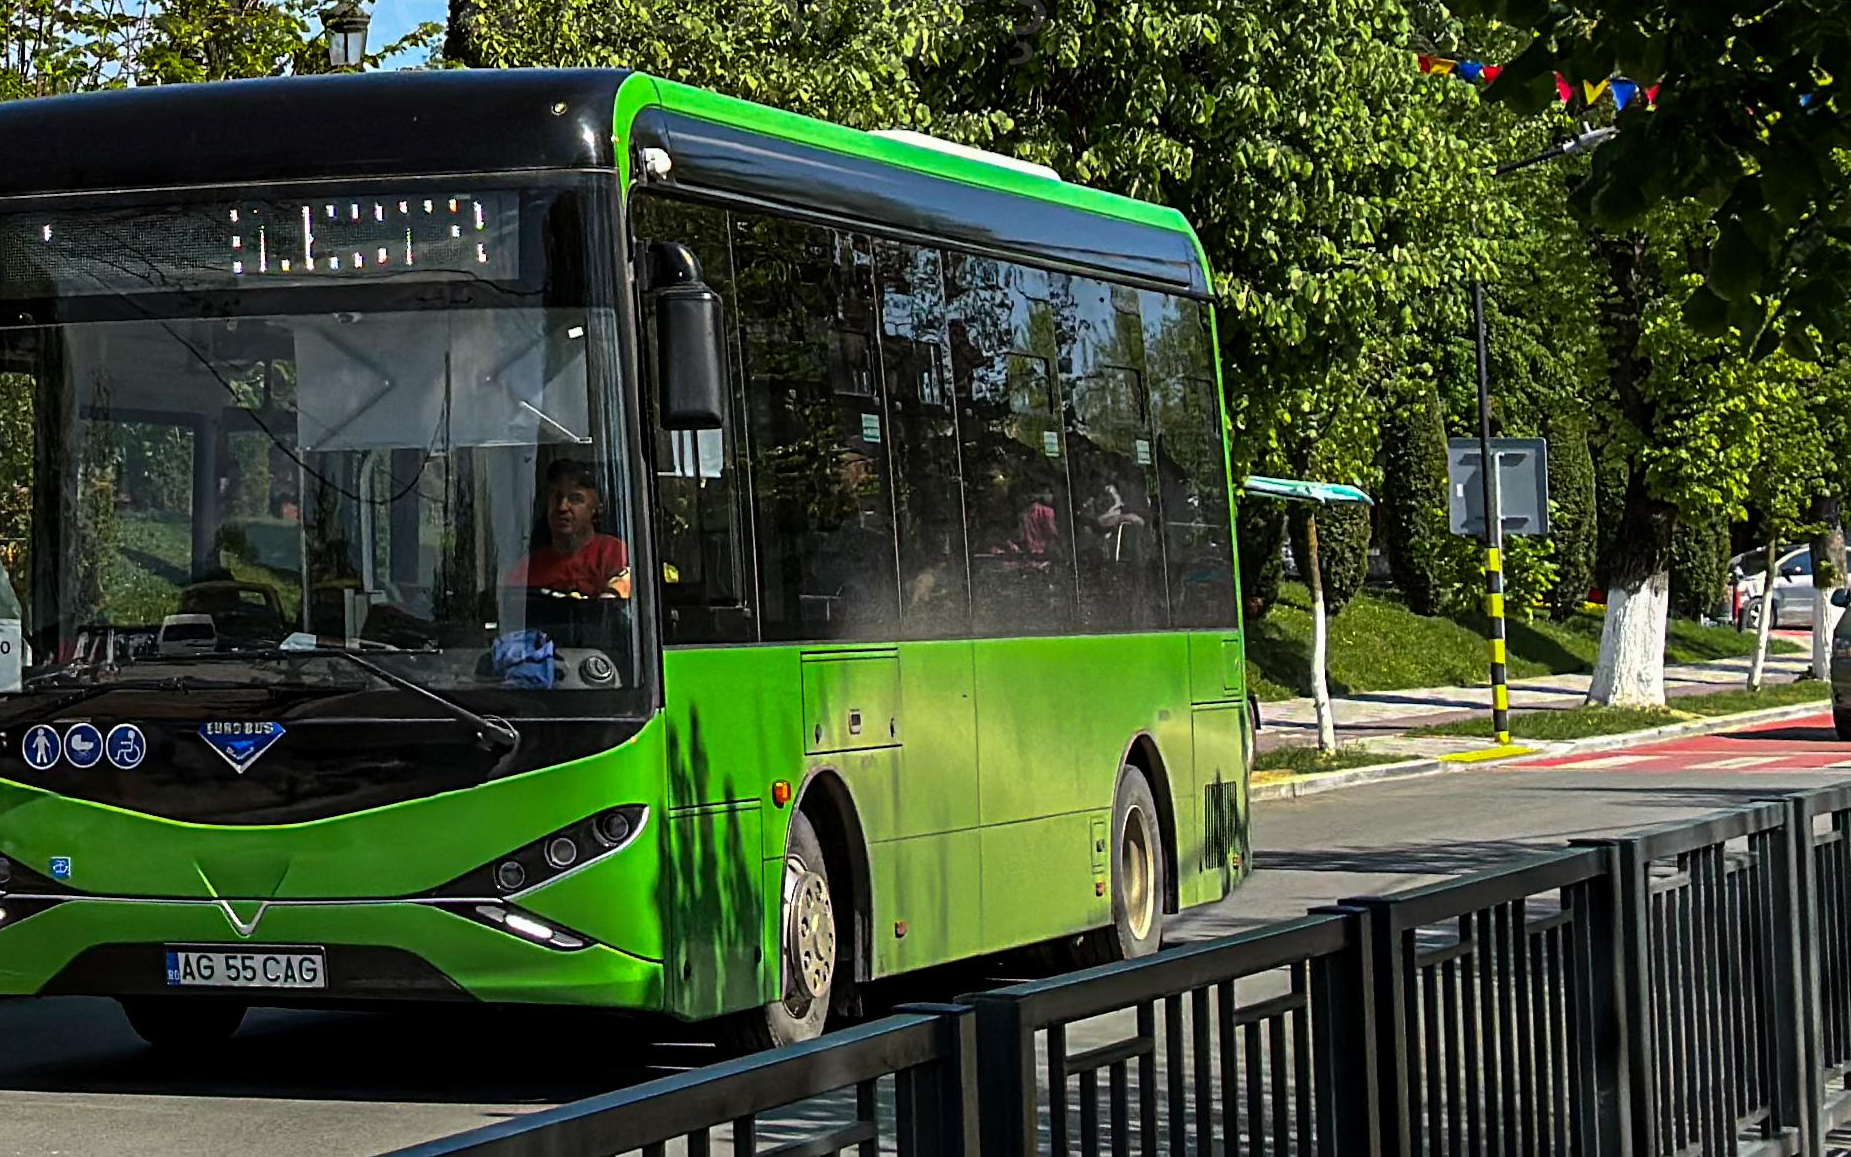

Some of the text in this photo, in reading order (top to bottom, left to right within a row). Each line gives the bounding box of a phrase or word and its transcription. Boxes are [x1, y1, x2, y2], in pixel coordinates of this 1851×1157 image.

[182, 953, 215, 980] AG
[224, 955, 257, 981] 55
[262, 956, 317, 983] CAG
